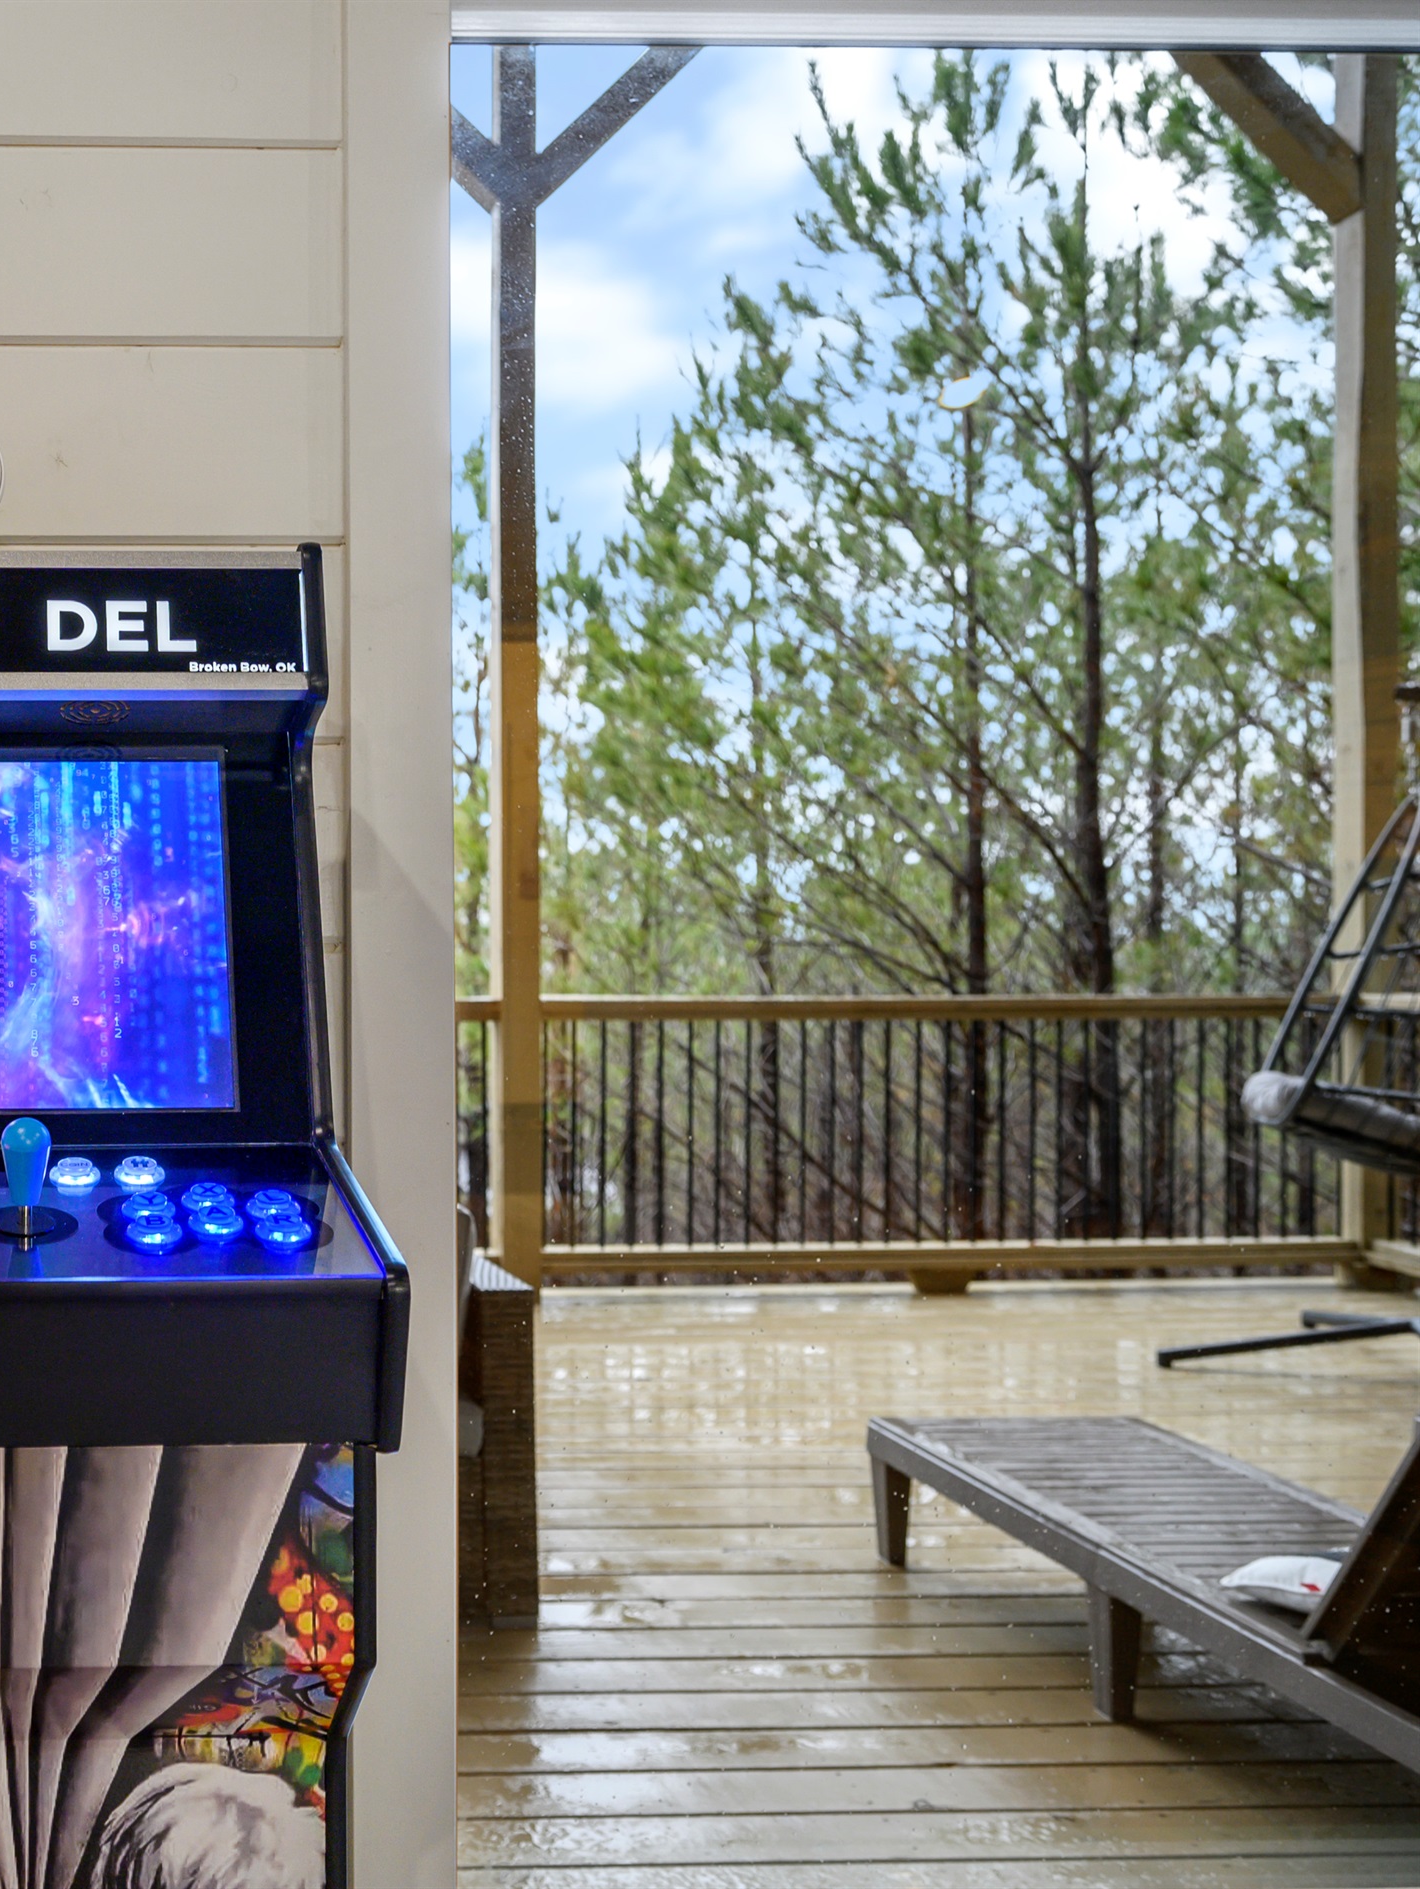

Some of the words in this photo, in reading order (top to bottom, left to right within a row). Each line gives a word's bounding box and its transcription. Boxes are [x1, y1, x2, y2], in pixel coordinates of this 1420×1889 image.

[46, 600, 198, 652] DEL
[189, 661, 237, 673] Broken
[275, 662, 297, 673] OK
